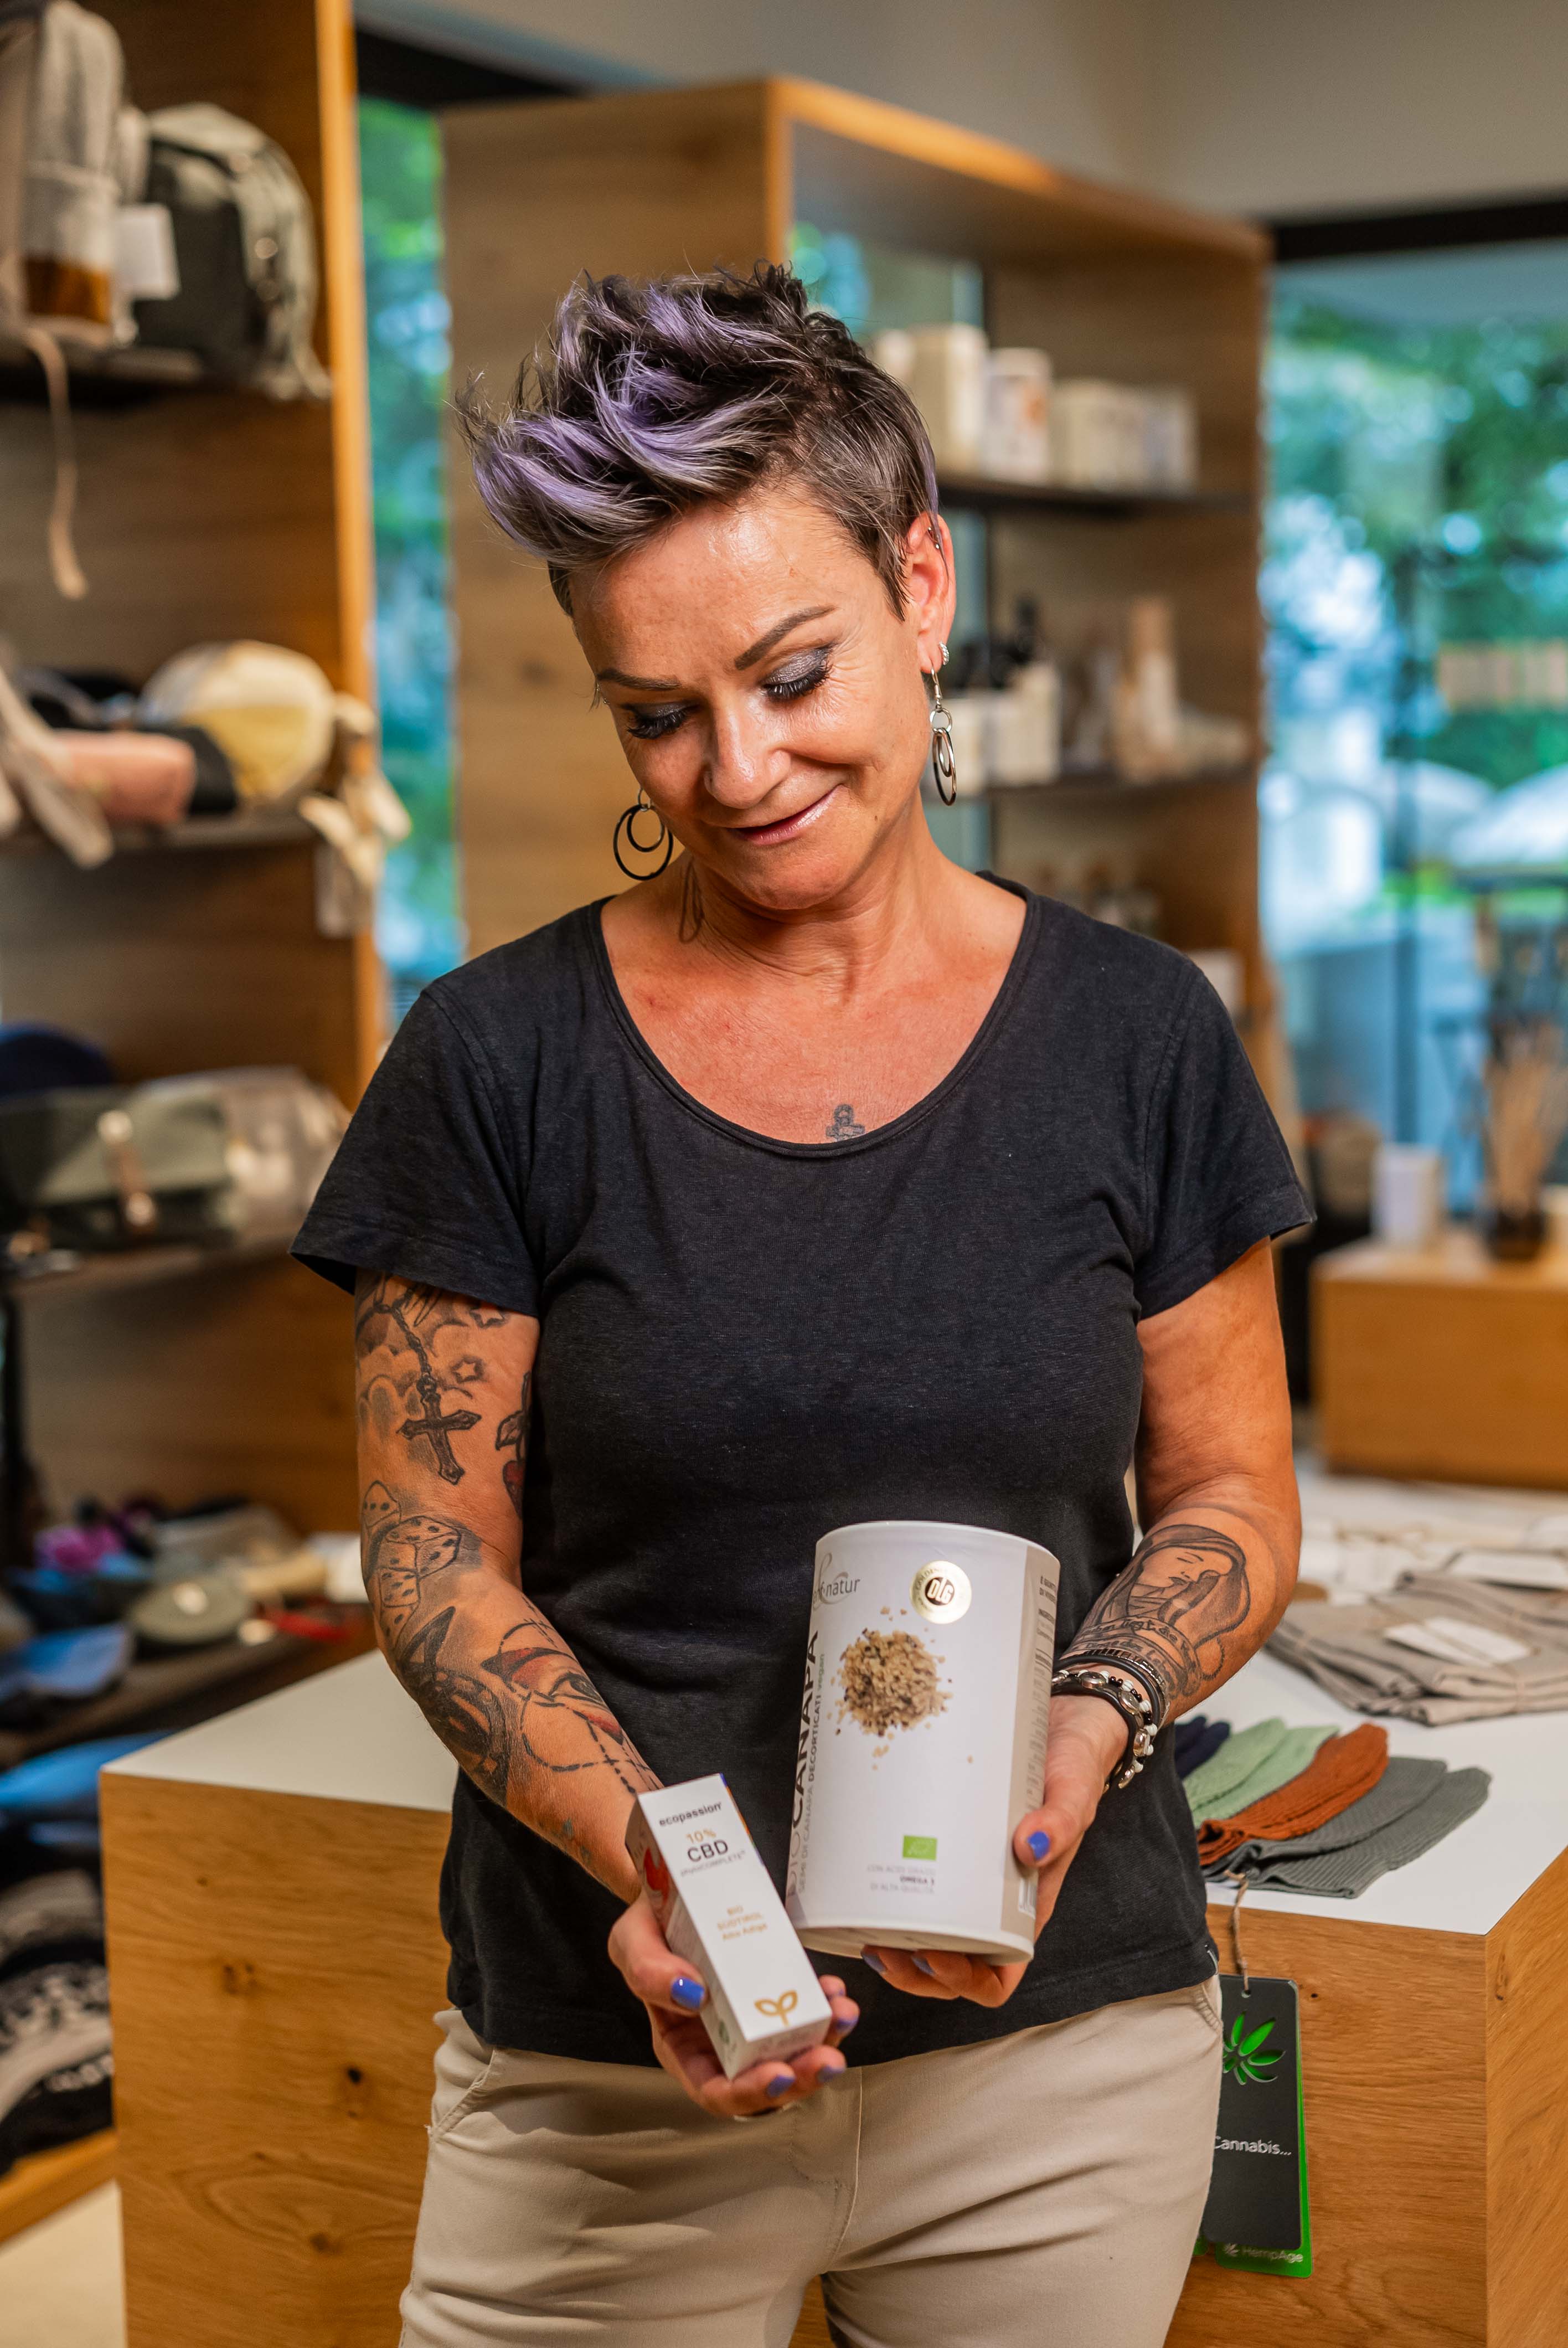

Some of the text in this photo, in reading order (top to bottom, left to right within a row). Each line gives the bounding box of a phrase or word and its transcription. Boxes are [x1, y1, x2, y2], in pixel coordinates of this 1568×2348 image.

[808, 1694, 822, 1782] DECORTICATI
[659, 1801, 721, 1827] ecopassion
[686, 1828, 717, 1844] 10%
[687, 1839, 729, 1862] CBD
[899, 1875, 928, 1884] OMEGA
